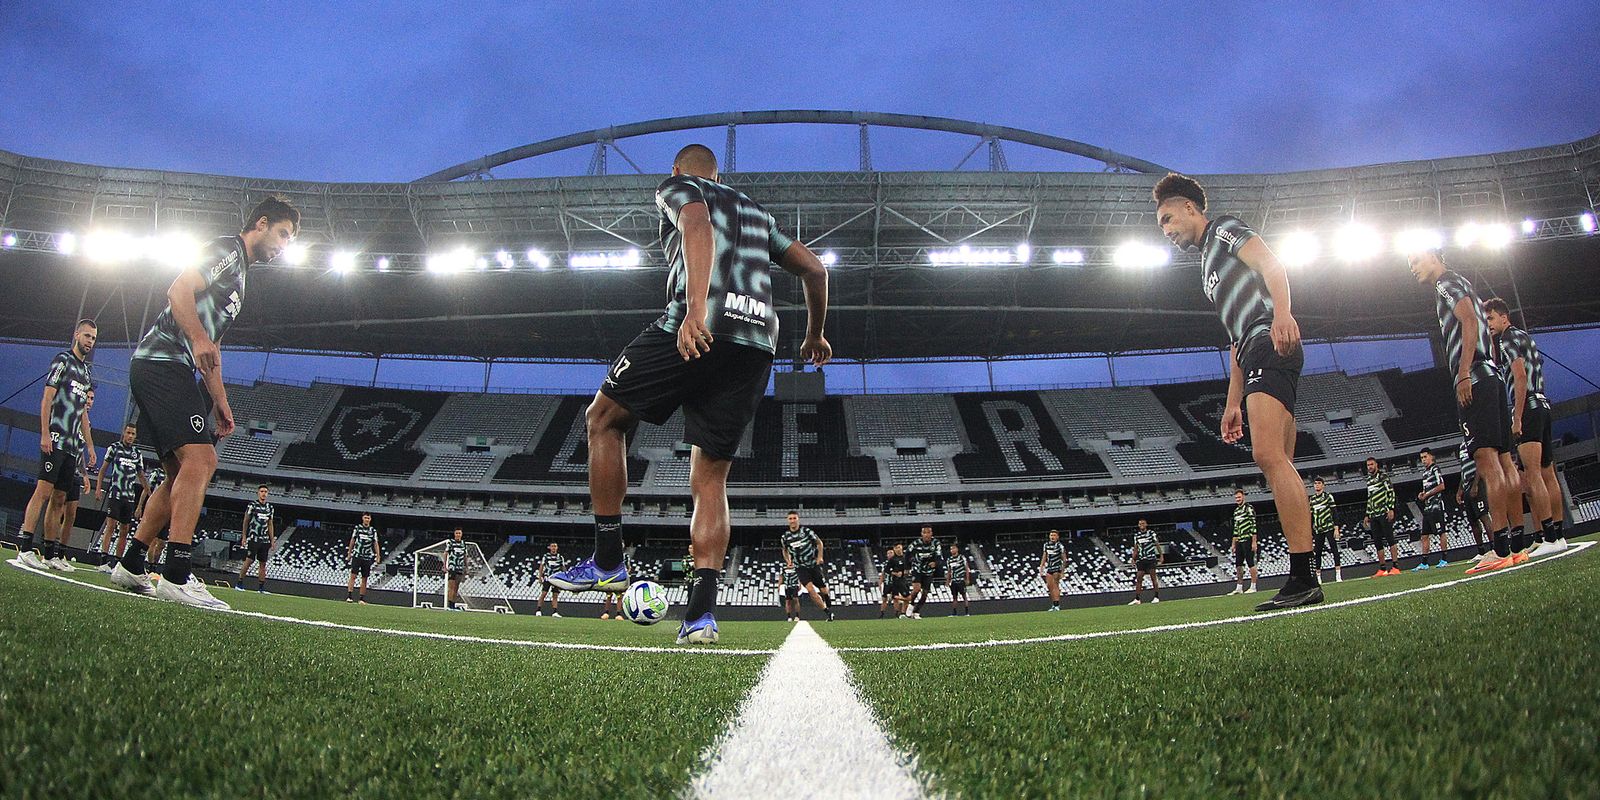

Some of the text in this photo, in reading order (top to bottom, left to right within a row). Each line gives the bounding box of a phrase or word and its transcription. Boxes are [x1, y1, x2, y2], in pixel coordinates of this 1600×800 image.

[210, 250, 238, 277] Centrum
[724, 311, 744, 320] Aluguel
[750, 319, 766, 327] carros
[613, 355, 631, 378] 17
[781, 403, 819, 478] F
[981, 400, 1064, 473] R
